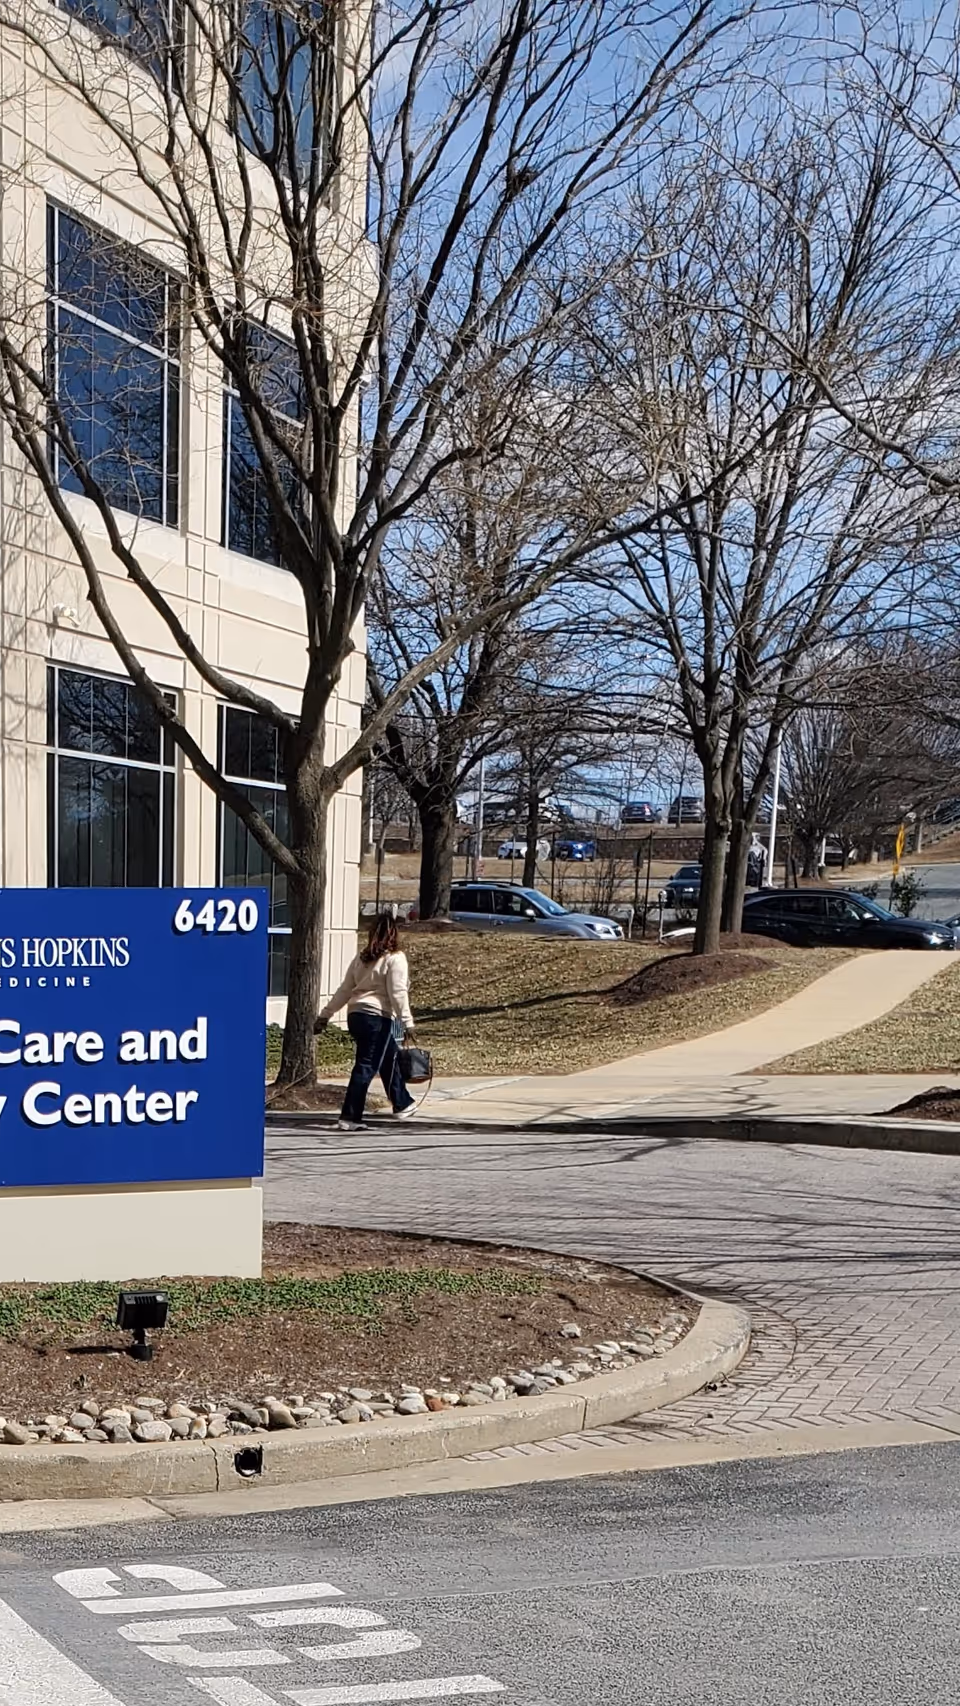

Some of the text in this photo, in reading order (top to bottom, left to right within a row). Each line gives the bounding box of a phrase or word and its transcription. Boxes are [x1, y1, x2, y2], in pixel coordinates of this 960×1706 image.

[174, 899, 259, 932] 6420
[21, 936, 130, 968] HOPKINS
[119, 1016, 208, 1062] and
[22, 1081, 199, 1125] Center
